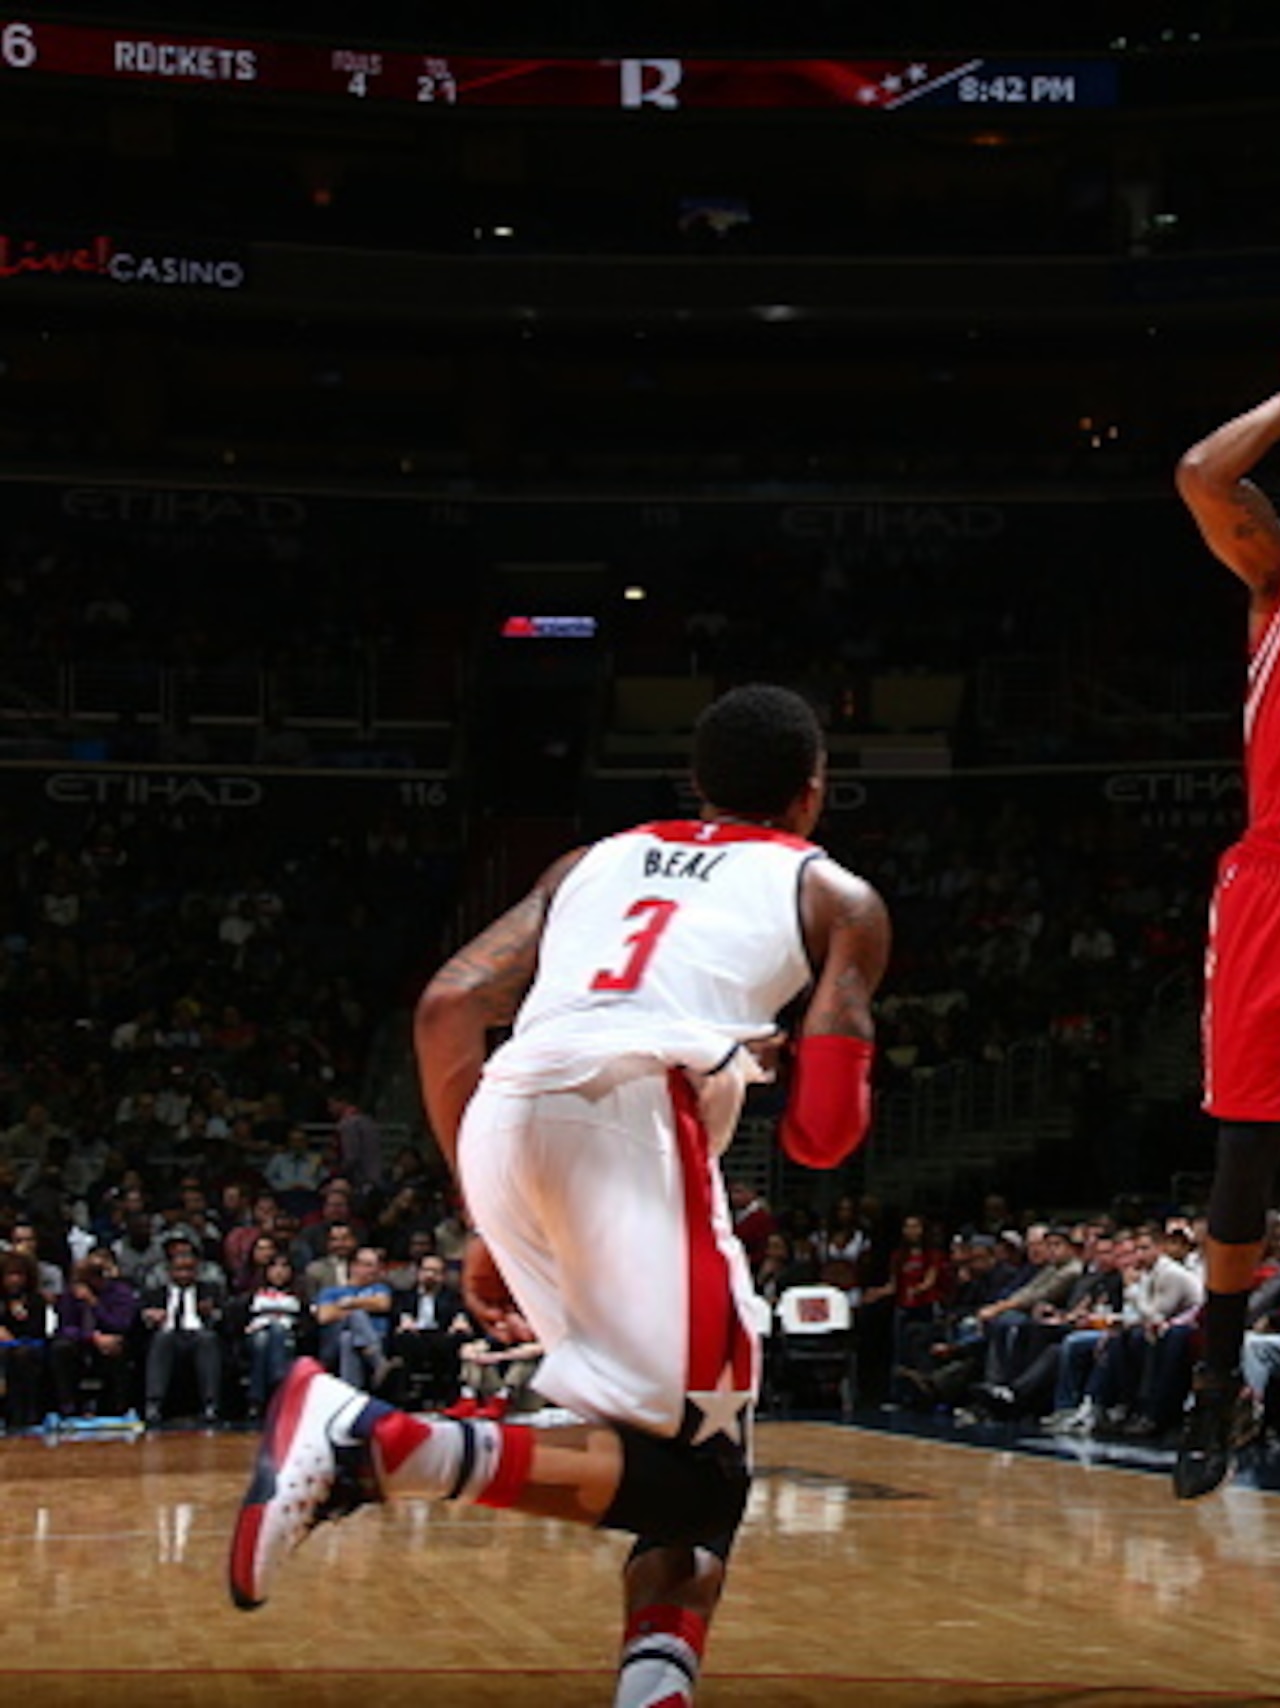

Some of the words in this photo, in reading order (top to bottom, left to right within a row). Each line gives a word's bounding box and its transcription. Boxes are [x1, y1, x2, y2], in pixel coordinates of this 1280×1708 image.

[1, 22, 37, 69] 6
[113, 40, 257, 81] ROCKETS
[346, 71, 367, 99] 4
[958, 76, 1027, 102] 8:42
[1031, 76, 1075, 102] PM
[107, 252, 246, 289] CASINO
[44, 773, 265, 808] ETIHAD
[401, 778, 449, 808] 116
[1104, 772, 1244, 803] ETIHA
[643, 847, 728, 882] BEAL
[589, 895, 679, 993] 3
